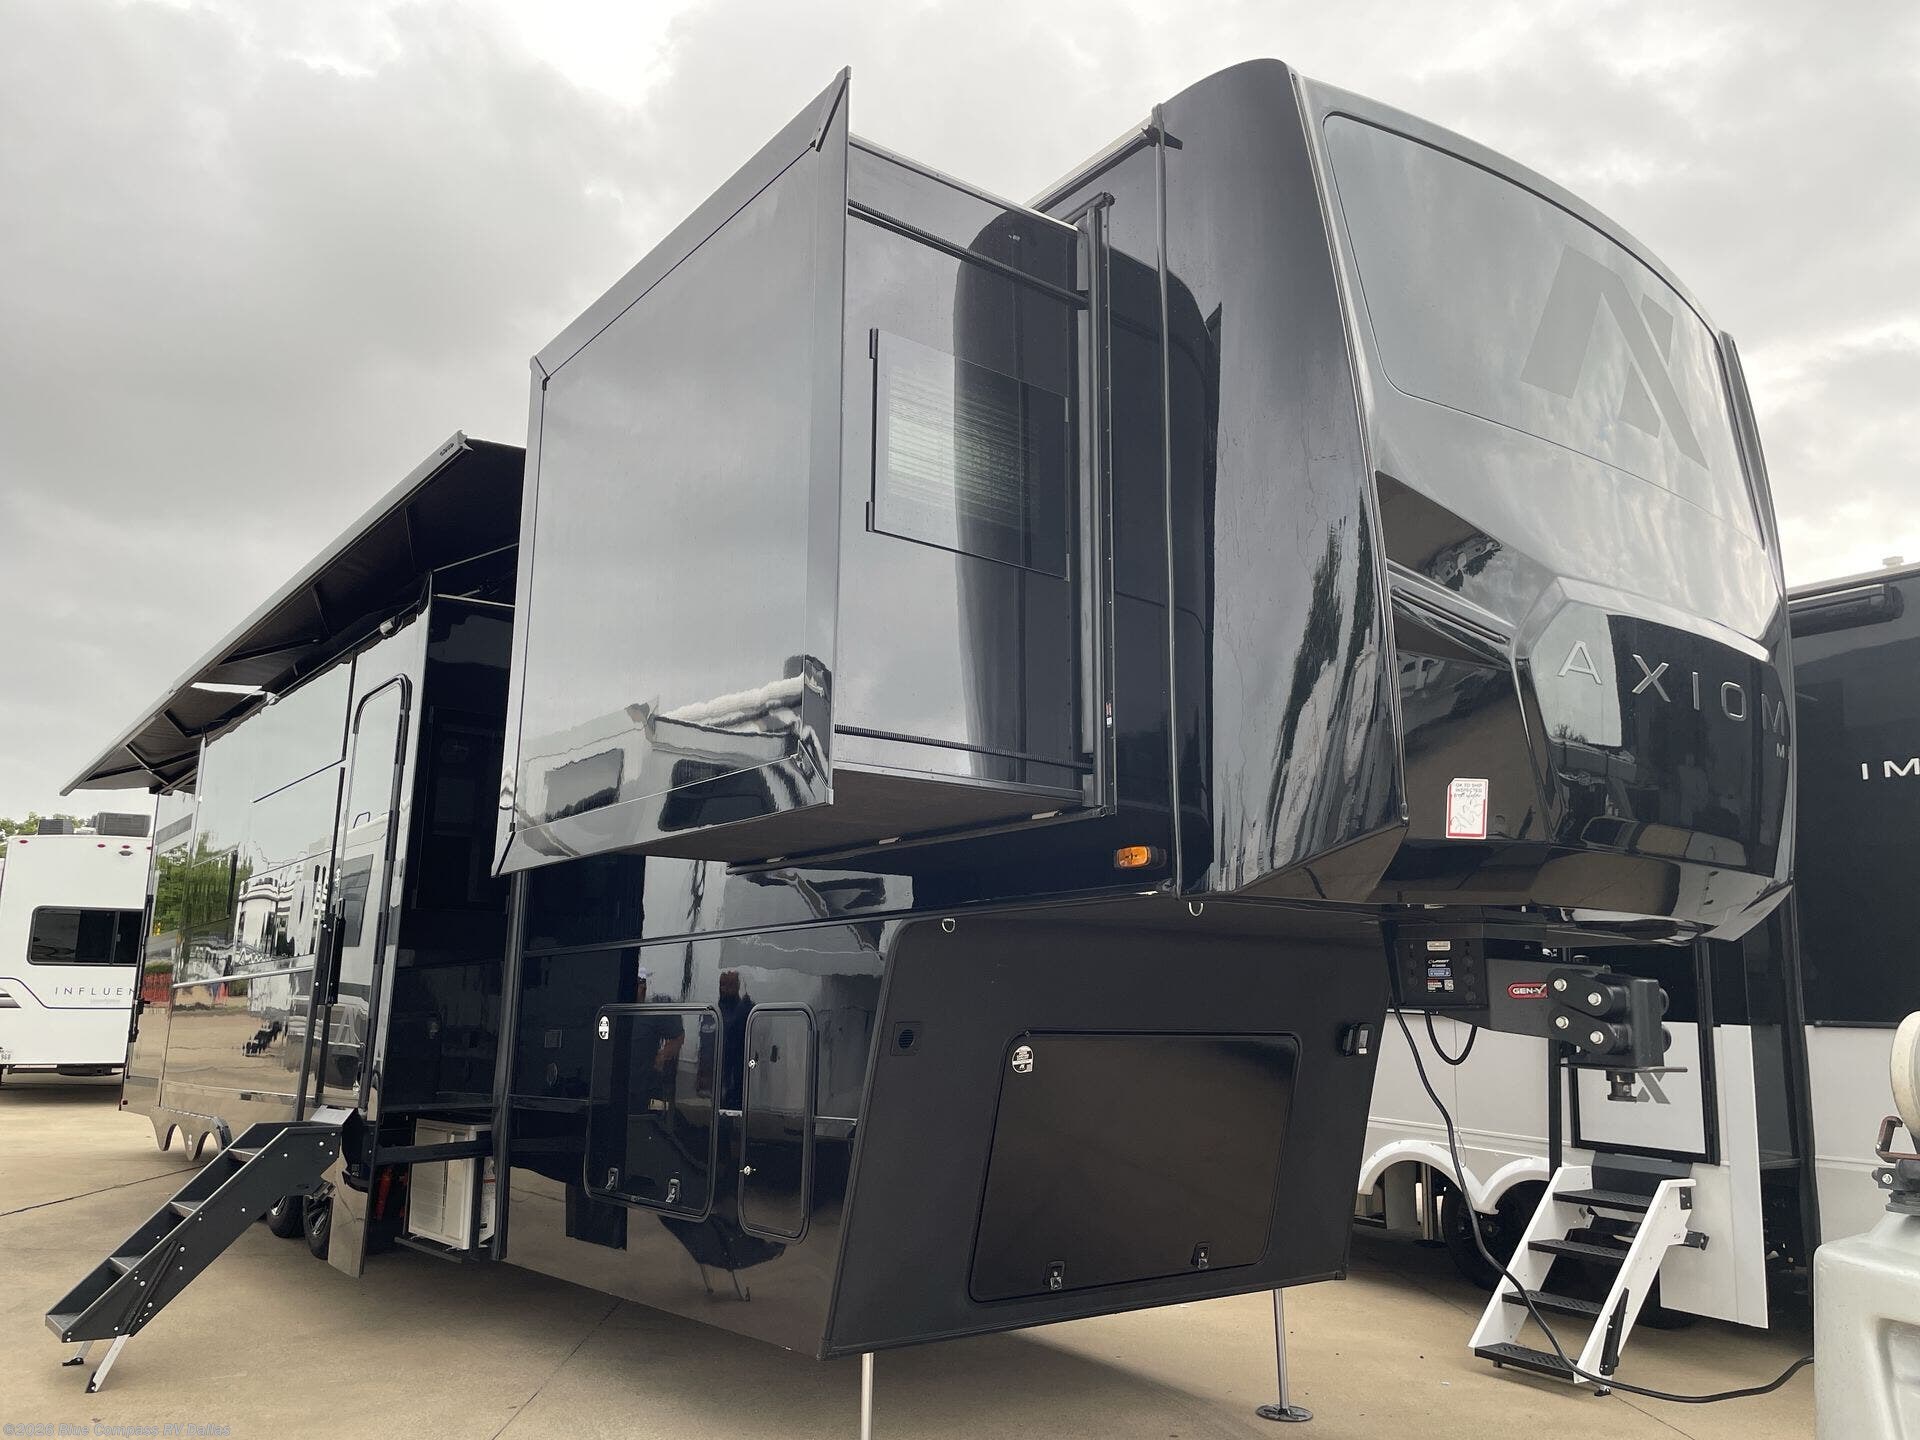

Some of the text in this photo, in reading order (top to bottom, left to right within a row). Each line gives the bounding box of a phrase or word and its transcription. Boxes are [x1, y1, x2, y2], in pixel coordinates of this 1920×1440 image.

[1557, 640, 1785, 737] AXIOM
[1861, 757, 1920, 780] IM
[1512, 983, 1547, 994] GEN-Y
